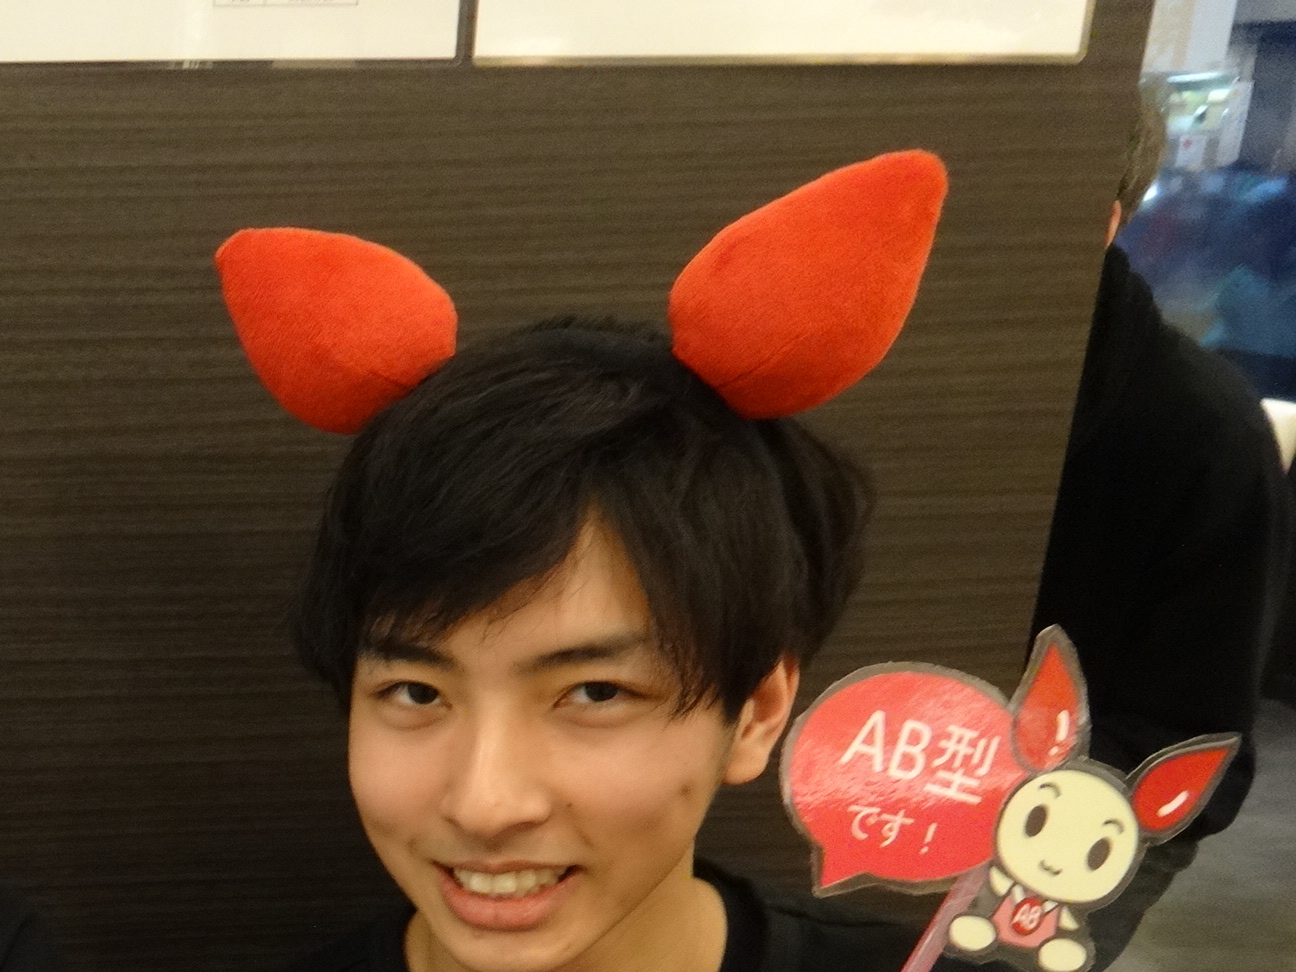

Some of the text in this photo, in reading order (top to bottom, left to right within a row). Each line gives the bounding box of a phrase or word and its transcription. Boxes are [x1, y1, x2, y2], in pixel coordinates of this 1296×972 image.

[840, 710, 1002, 804] AB型
[848, 804, 938, 854] です！
[1012, 902, 1042, 931] AB
